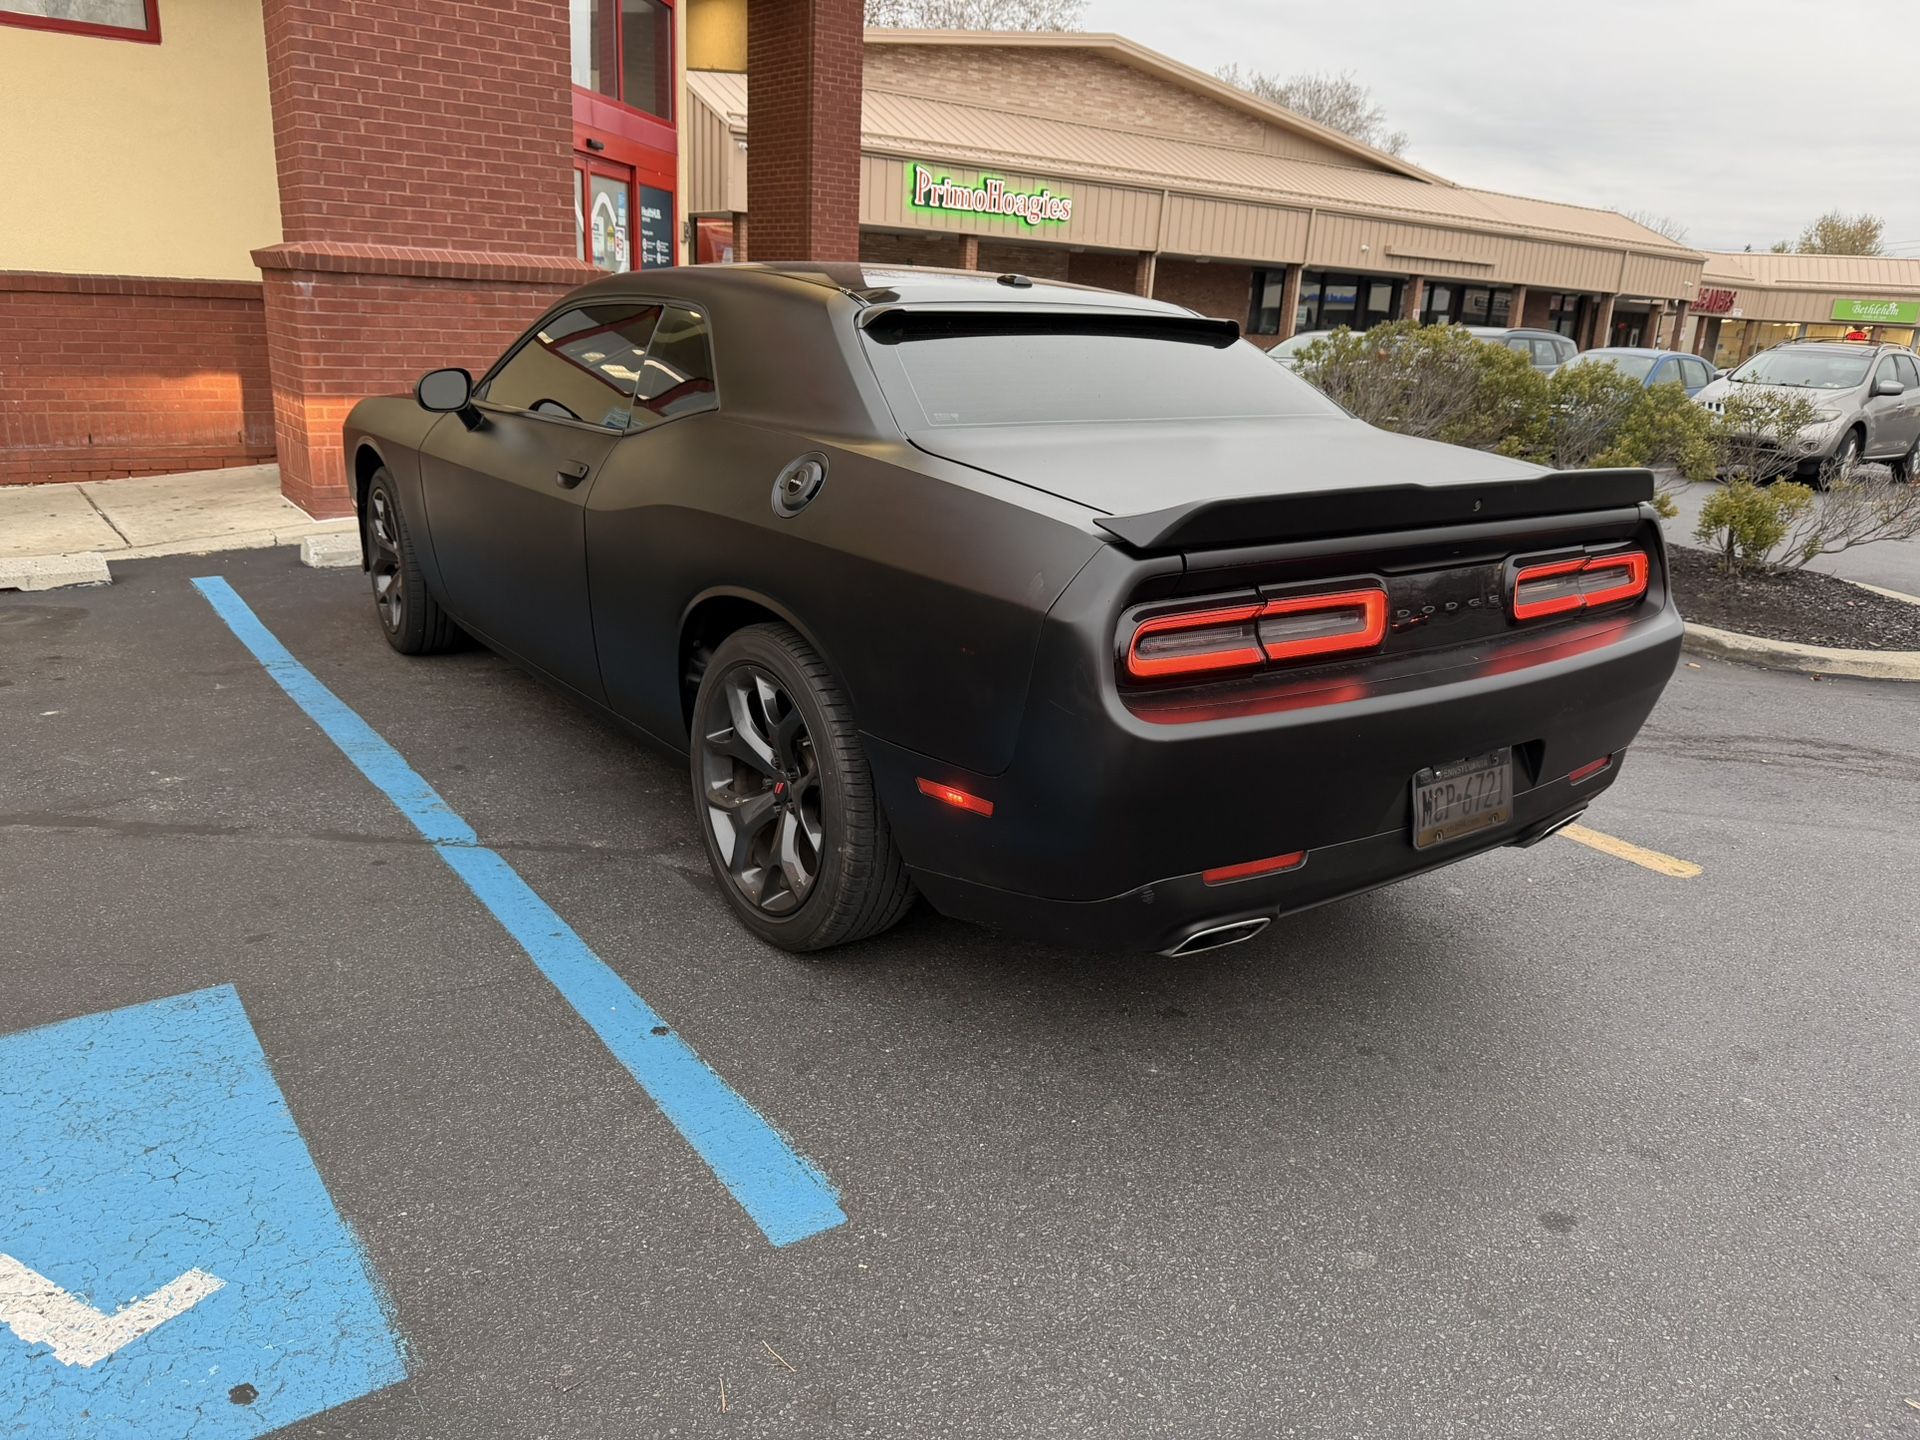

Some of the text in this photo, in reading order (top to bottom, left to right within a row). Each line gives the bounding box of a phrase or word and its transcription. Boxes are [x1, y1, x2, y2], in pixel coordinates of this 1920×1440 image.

[914, 164, 1072, 224] PrimoHoagies
[1852, 303, 1899, 316] Bethlehem
[1396, 594, 1500, 618] DODGE
